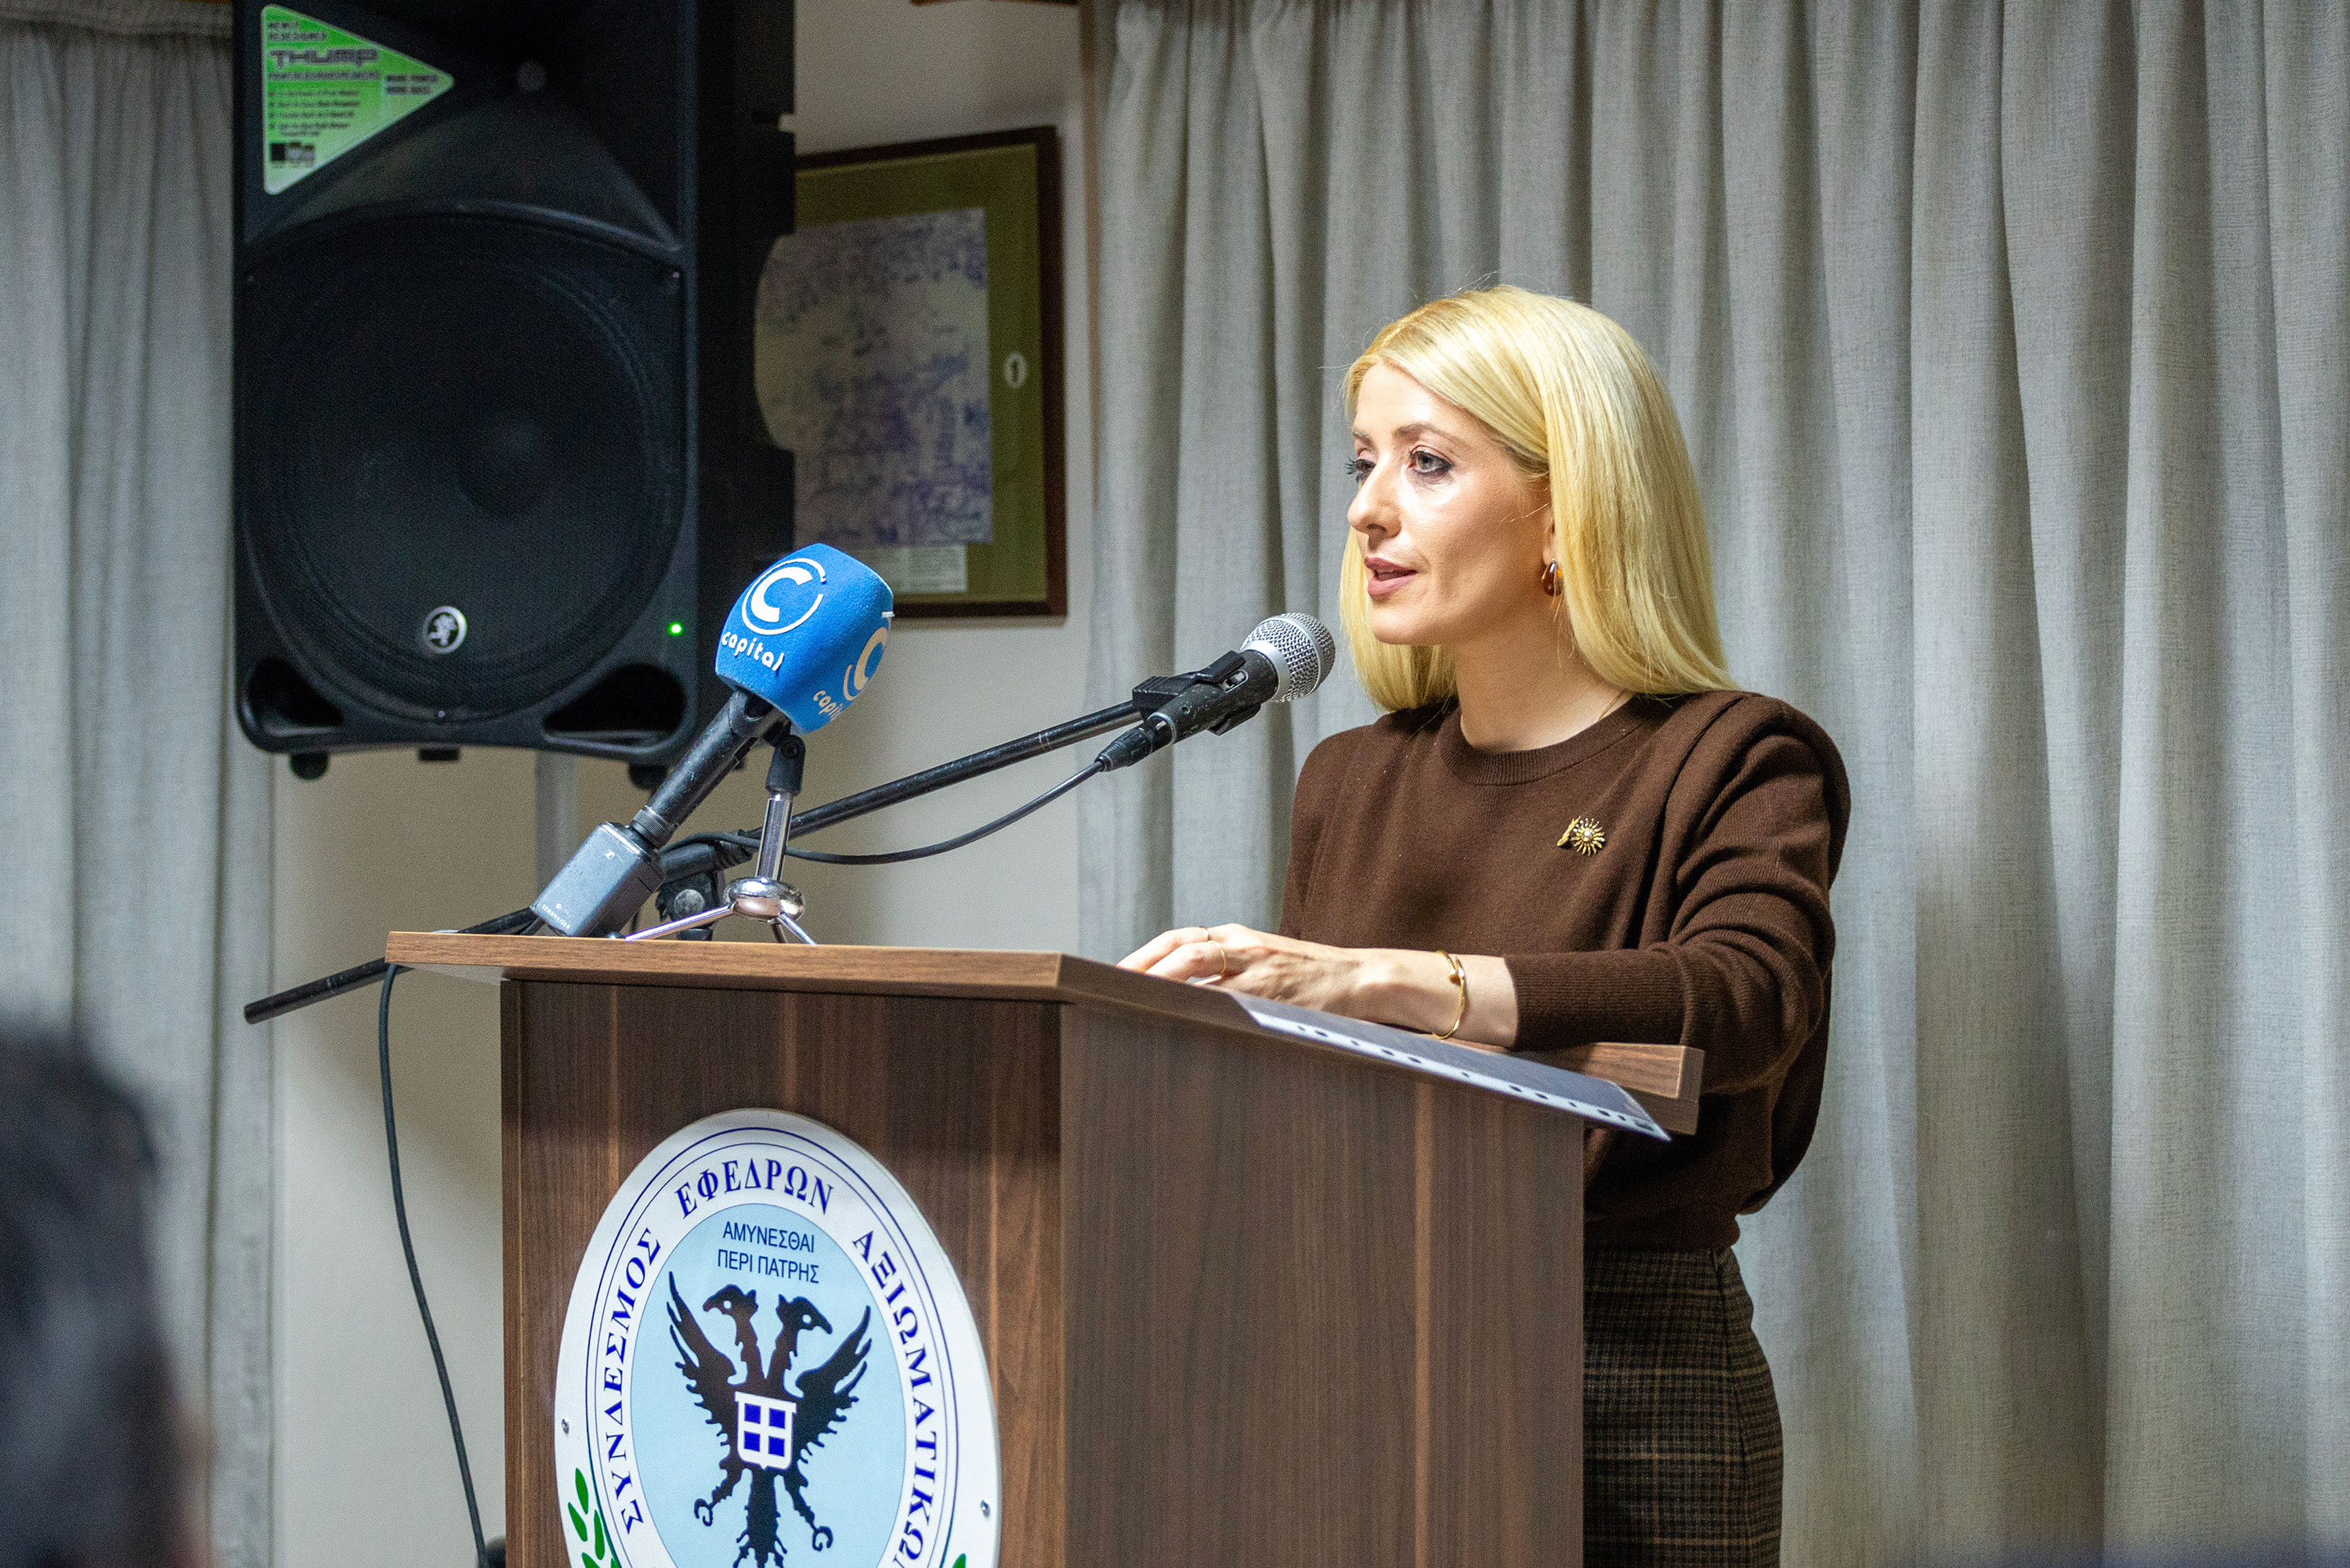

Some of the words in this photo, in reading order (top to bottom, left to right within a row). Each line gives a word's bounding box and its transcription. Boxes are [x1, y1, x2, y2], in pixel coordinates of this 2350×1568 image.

[721, 632, 784, 671] capital
[722, 1220, 815, 1254] ΑΜΥΝΕΣΘΑΙ
[718, 1248, 754, 1273] ΠΕΡΙ
[757, 1255, 819, 1284] ΠΑΤΡΗΣ
[603, 1227, 661, 1535] ΣΥΝΔΕΣΜΟΣ
[674, 1158, 834, 1219] ΕΦΕΔΡΩΝ
[851, 1230, 938, 1568] ΑΞΙΩΜΑΤΙΚΩ
